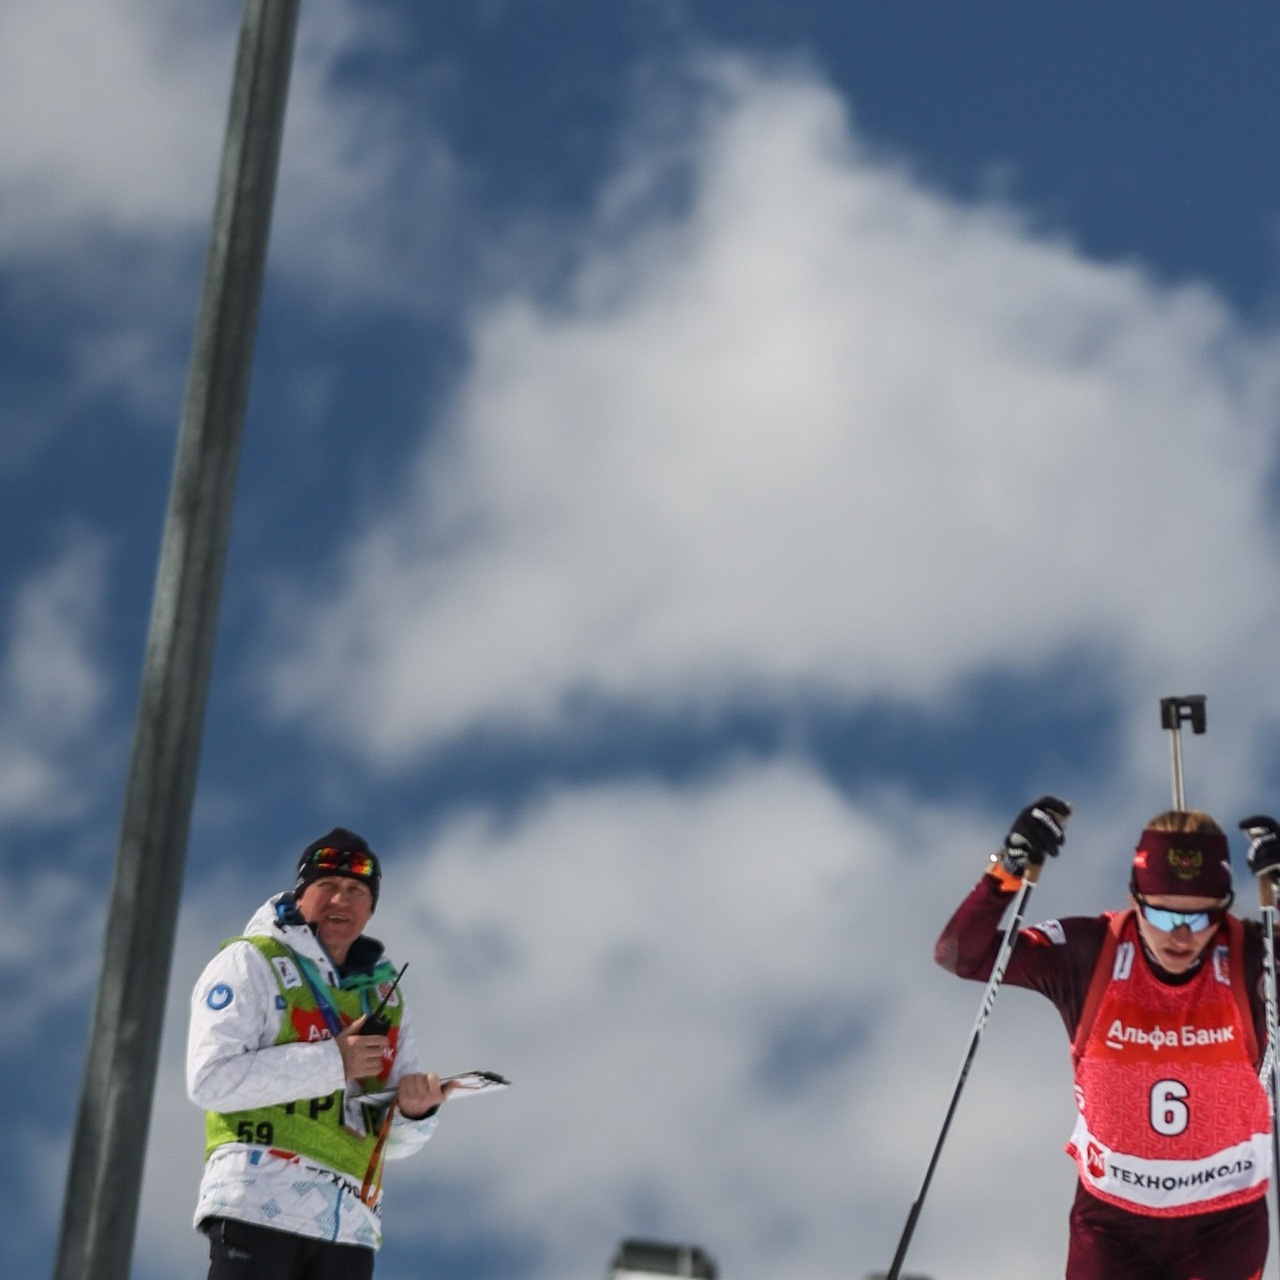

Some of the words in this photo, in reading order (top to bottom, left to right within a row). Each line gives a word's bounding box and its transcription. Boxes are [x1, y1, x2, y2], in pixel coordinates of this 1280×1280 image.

[1106, 1019, 1178, 1051] Альфа
[1181, 1025, 1234, 1047] Банк
[1151, 1078, 1189, 1136] 6
[236, 1121, 274, 1145] 59
[1110, 1160, 1254, 1191] ТЕХНОНИКОЛЬ
